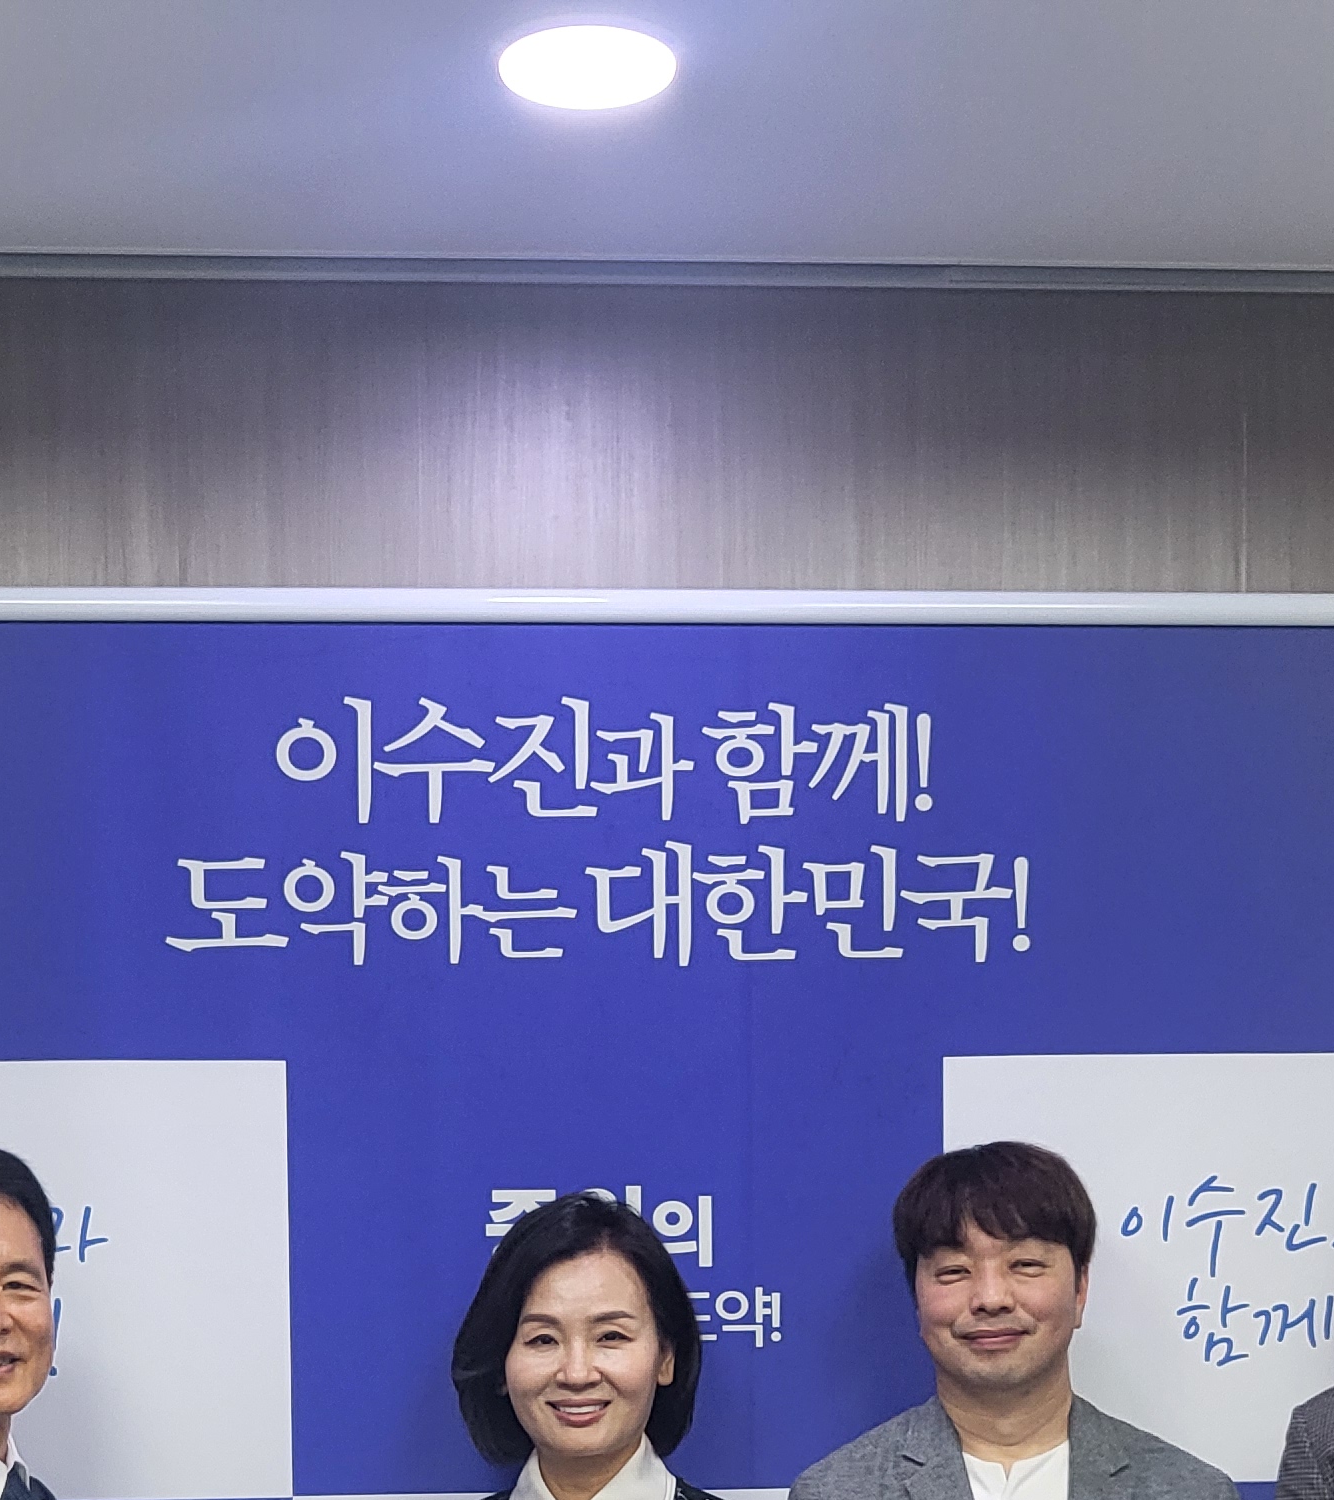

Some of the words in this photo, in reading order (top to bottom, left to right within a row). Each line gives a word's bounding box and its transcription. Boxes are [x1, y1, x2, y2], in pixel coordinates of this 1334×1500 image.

[275, 696, 694, 825] 이수진과
[701, 702, 934, 825] 함께!
[165, 850, 577, 966] 도약하는
[584, 840, 1031, 967] 대한민국!
